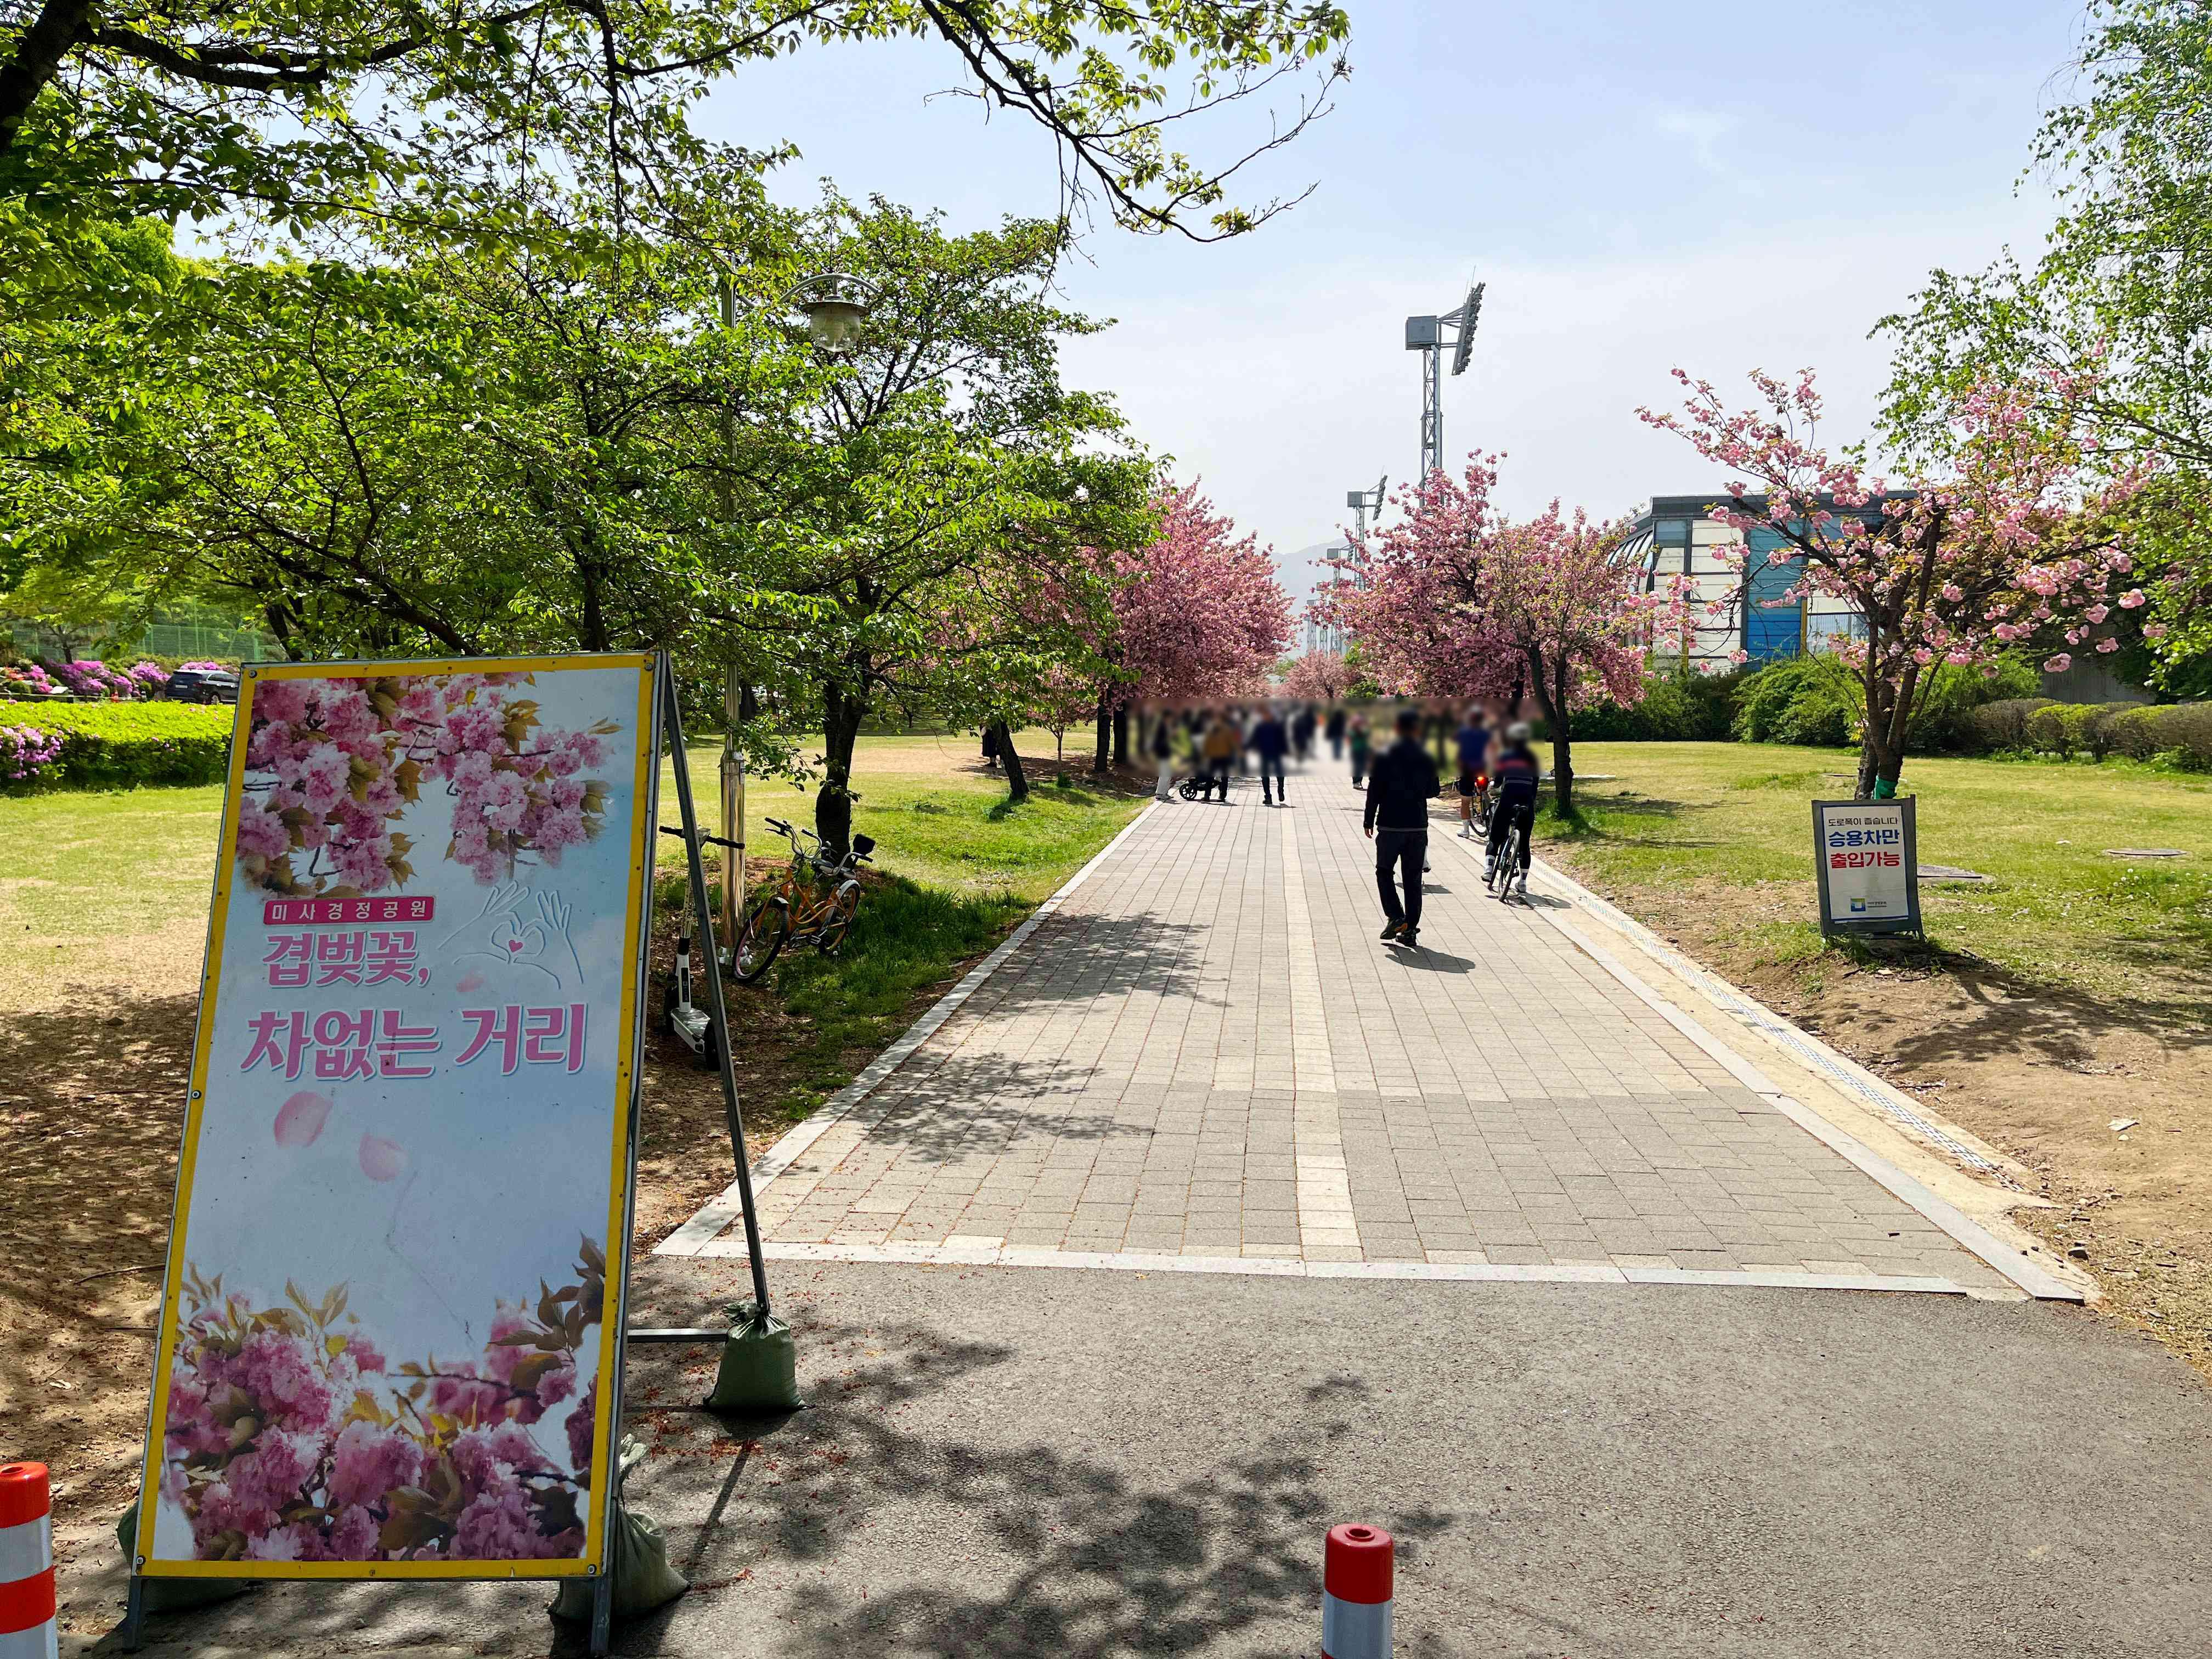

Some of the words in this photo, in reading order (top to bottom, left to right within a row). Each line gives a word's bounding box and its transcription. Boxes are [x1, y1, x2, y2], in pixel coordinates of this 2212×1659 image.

[1828, 817, 1861, 826] 도로폭이
[1829, 830, 1900, 848] 승용차만
[1830, 851, 1900, 869] 출입가능
[272, 900, 427, 921] 미사경정공원
[262, 930, 431, 988] 겹벚꽃,
[240, 1008, 442, 1081] 차없는
[454, 1003, 589, 1076] 거리
